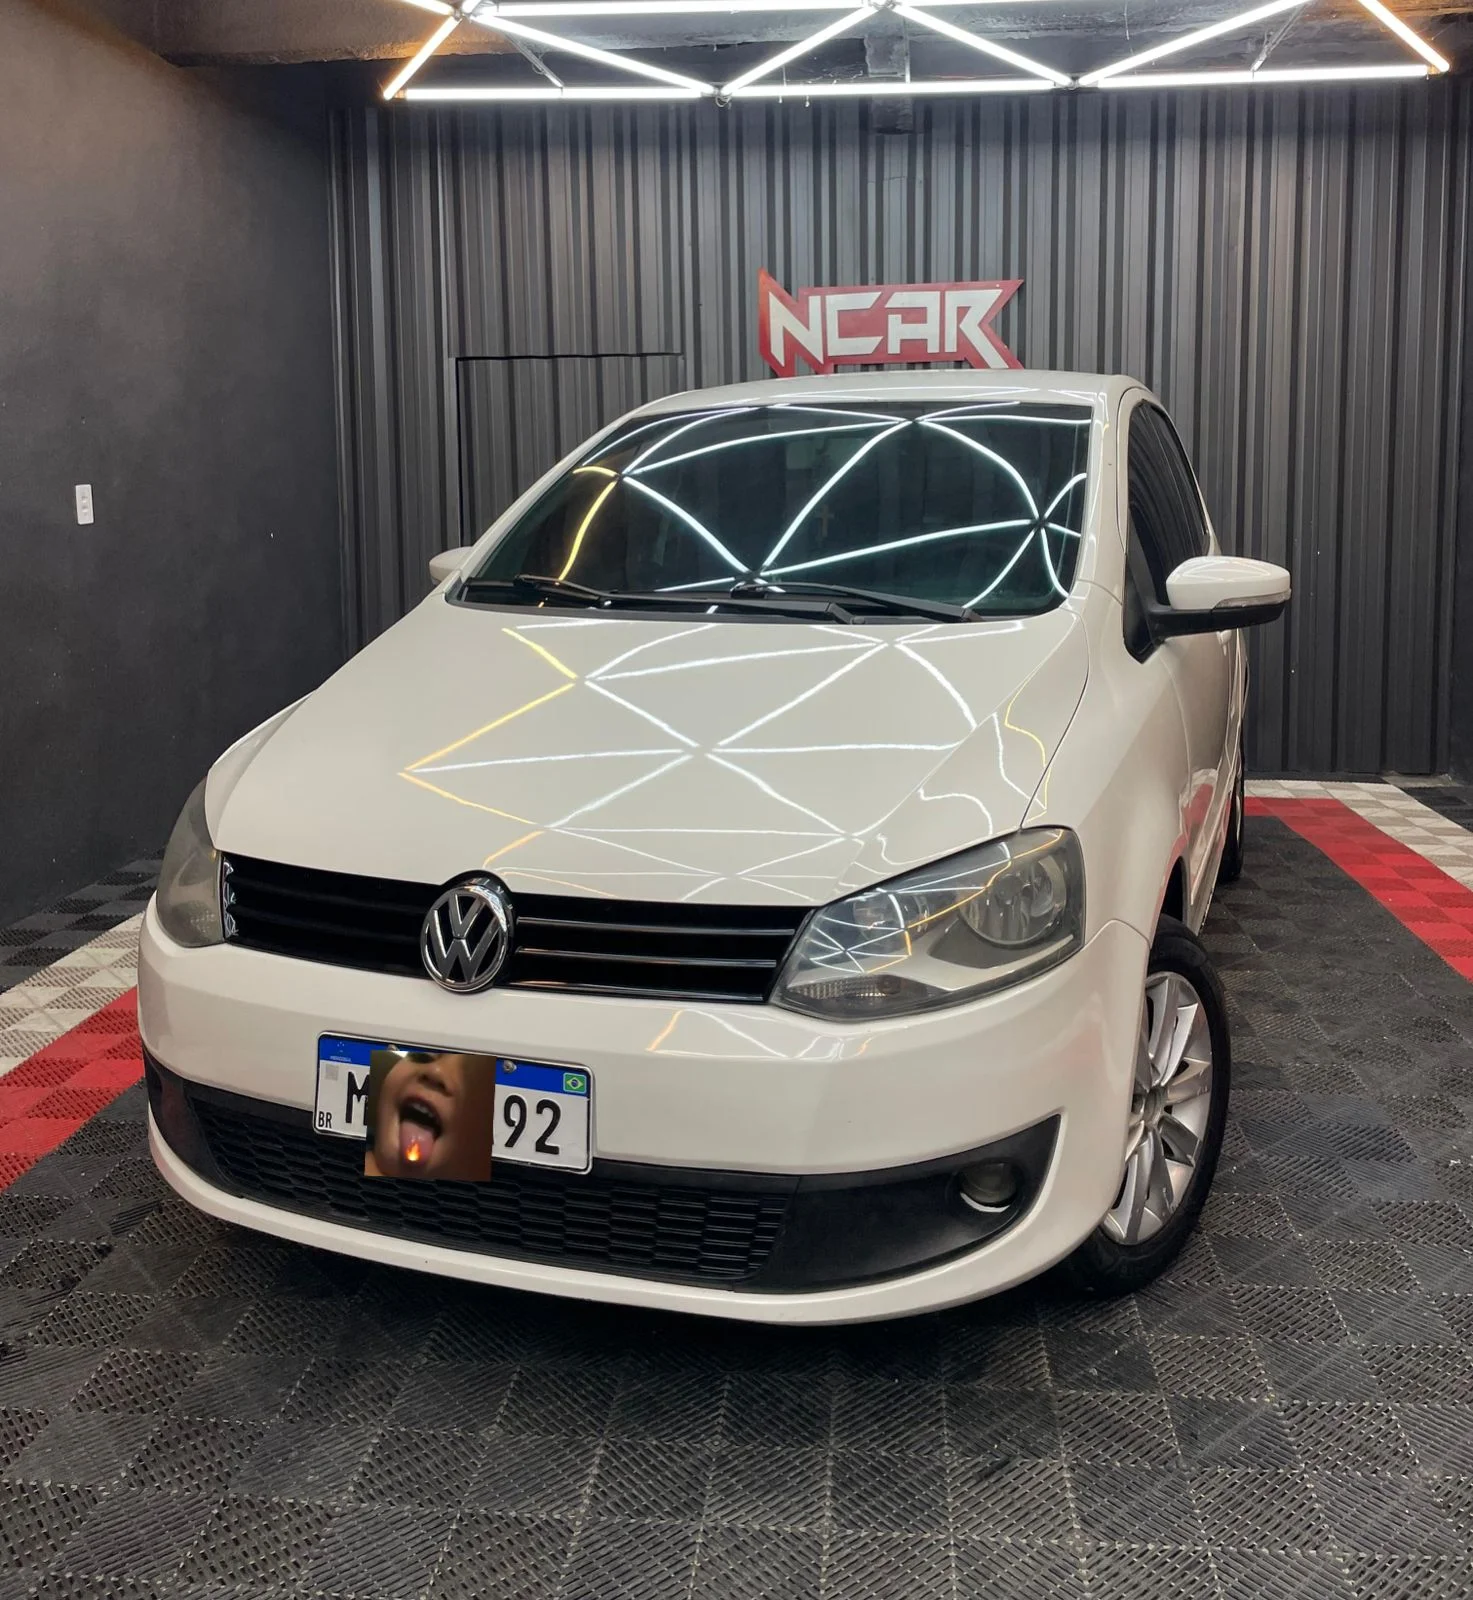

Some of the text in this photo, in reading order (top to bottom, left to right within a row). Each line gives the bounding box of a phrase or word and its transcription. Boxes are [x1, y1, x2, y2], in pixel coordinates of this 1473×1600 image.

[768, 289, 1009, 368] NCAR
[424, 889, 504, 987] VW
[318, 1111, 333, 1129] BR
